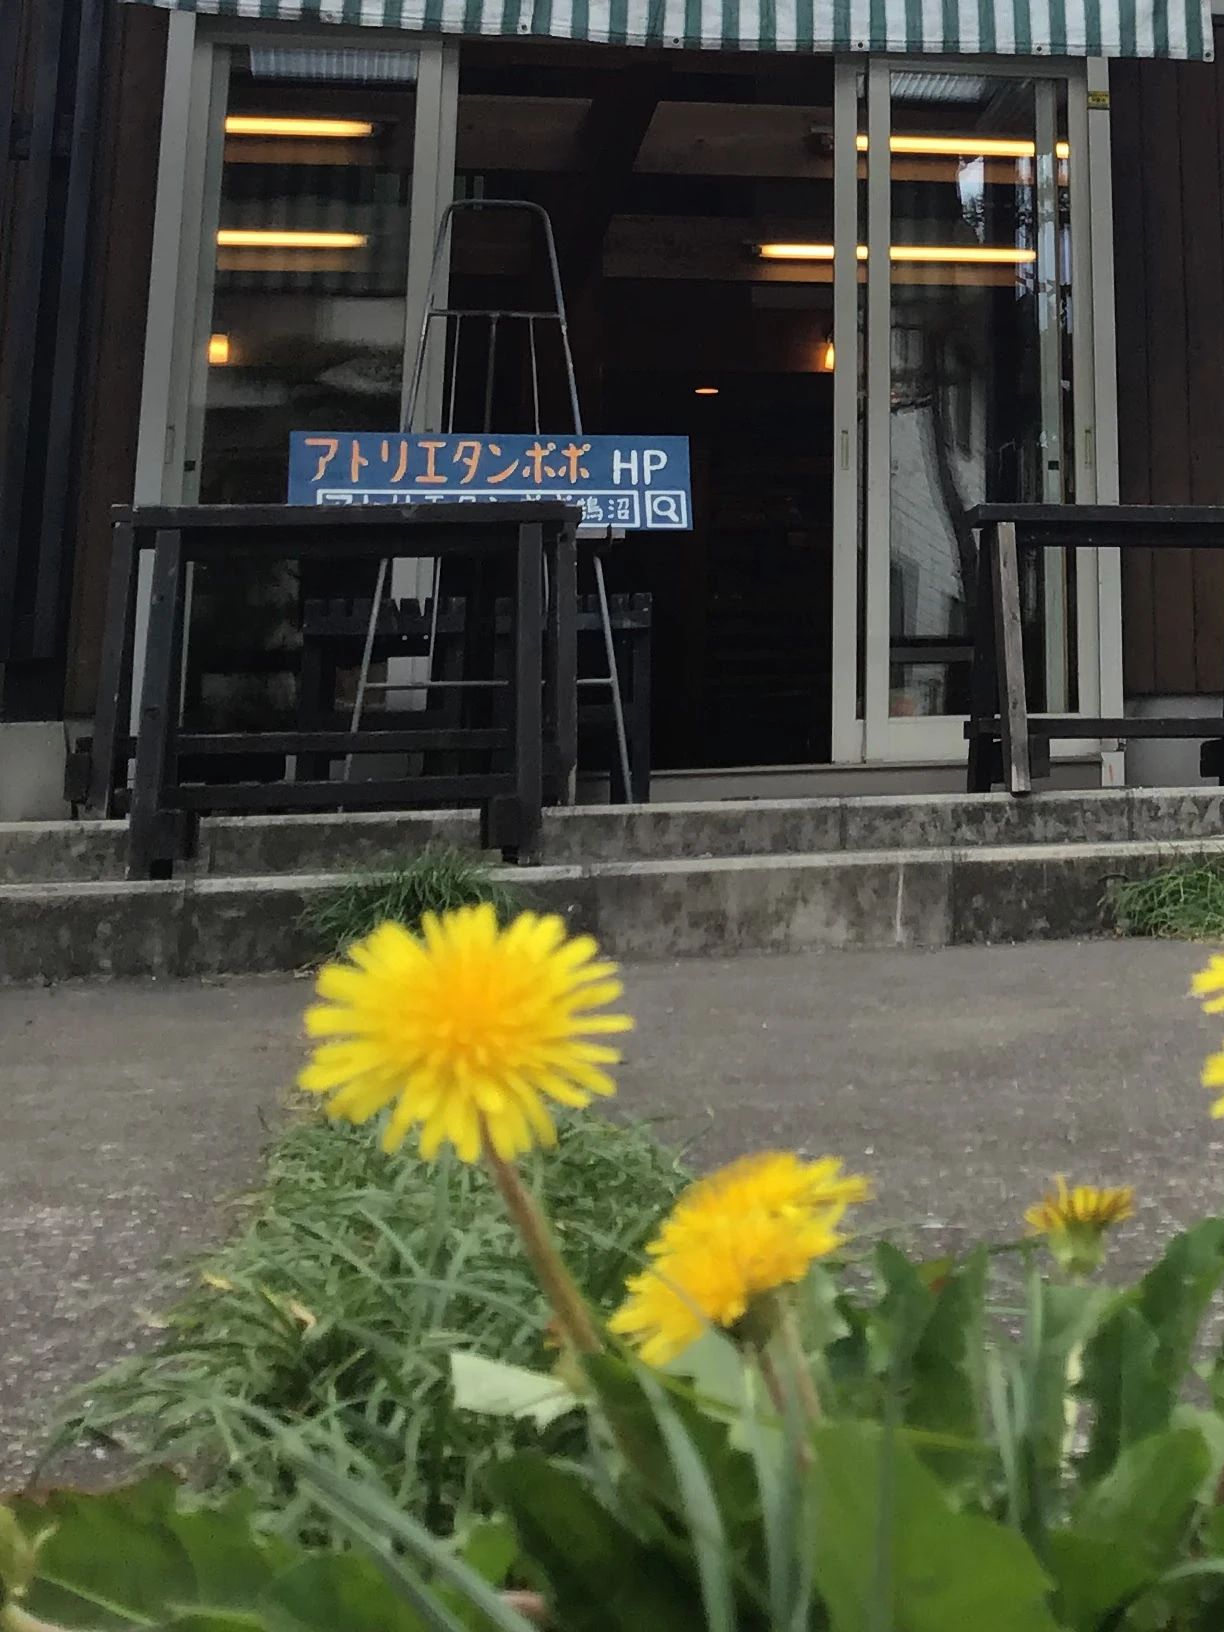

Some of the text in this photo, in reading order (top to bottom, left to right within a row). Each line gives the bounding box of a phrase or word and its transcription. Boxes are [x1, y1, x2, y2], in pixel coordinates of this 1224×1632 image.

[304, 438, 668, 485] アトリエタンポポ HP
